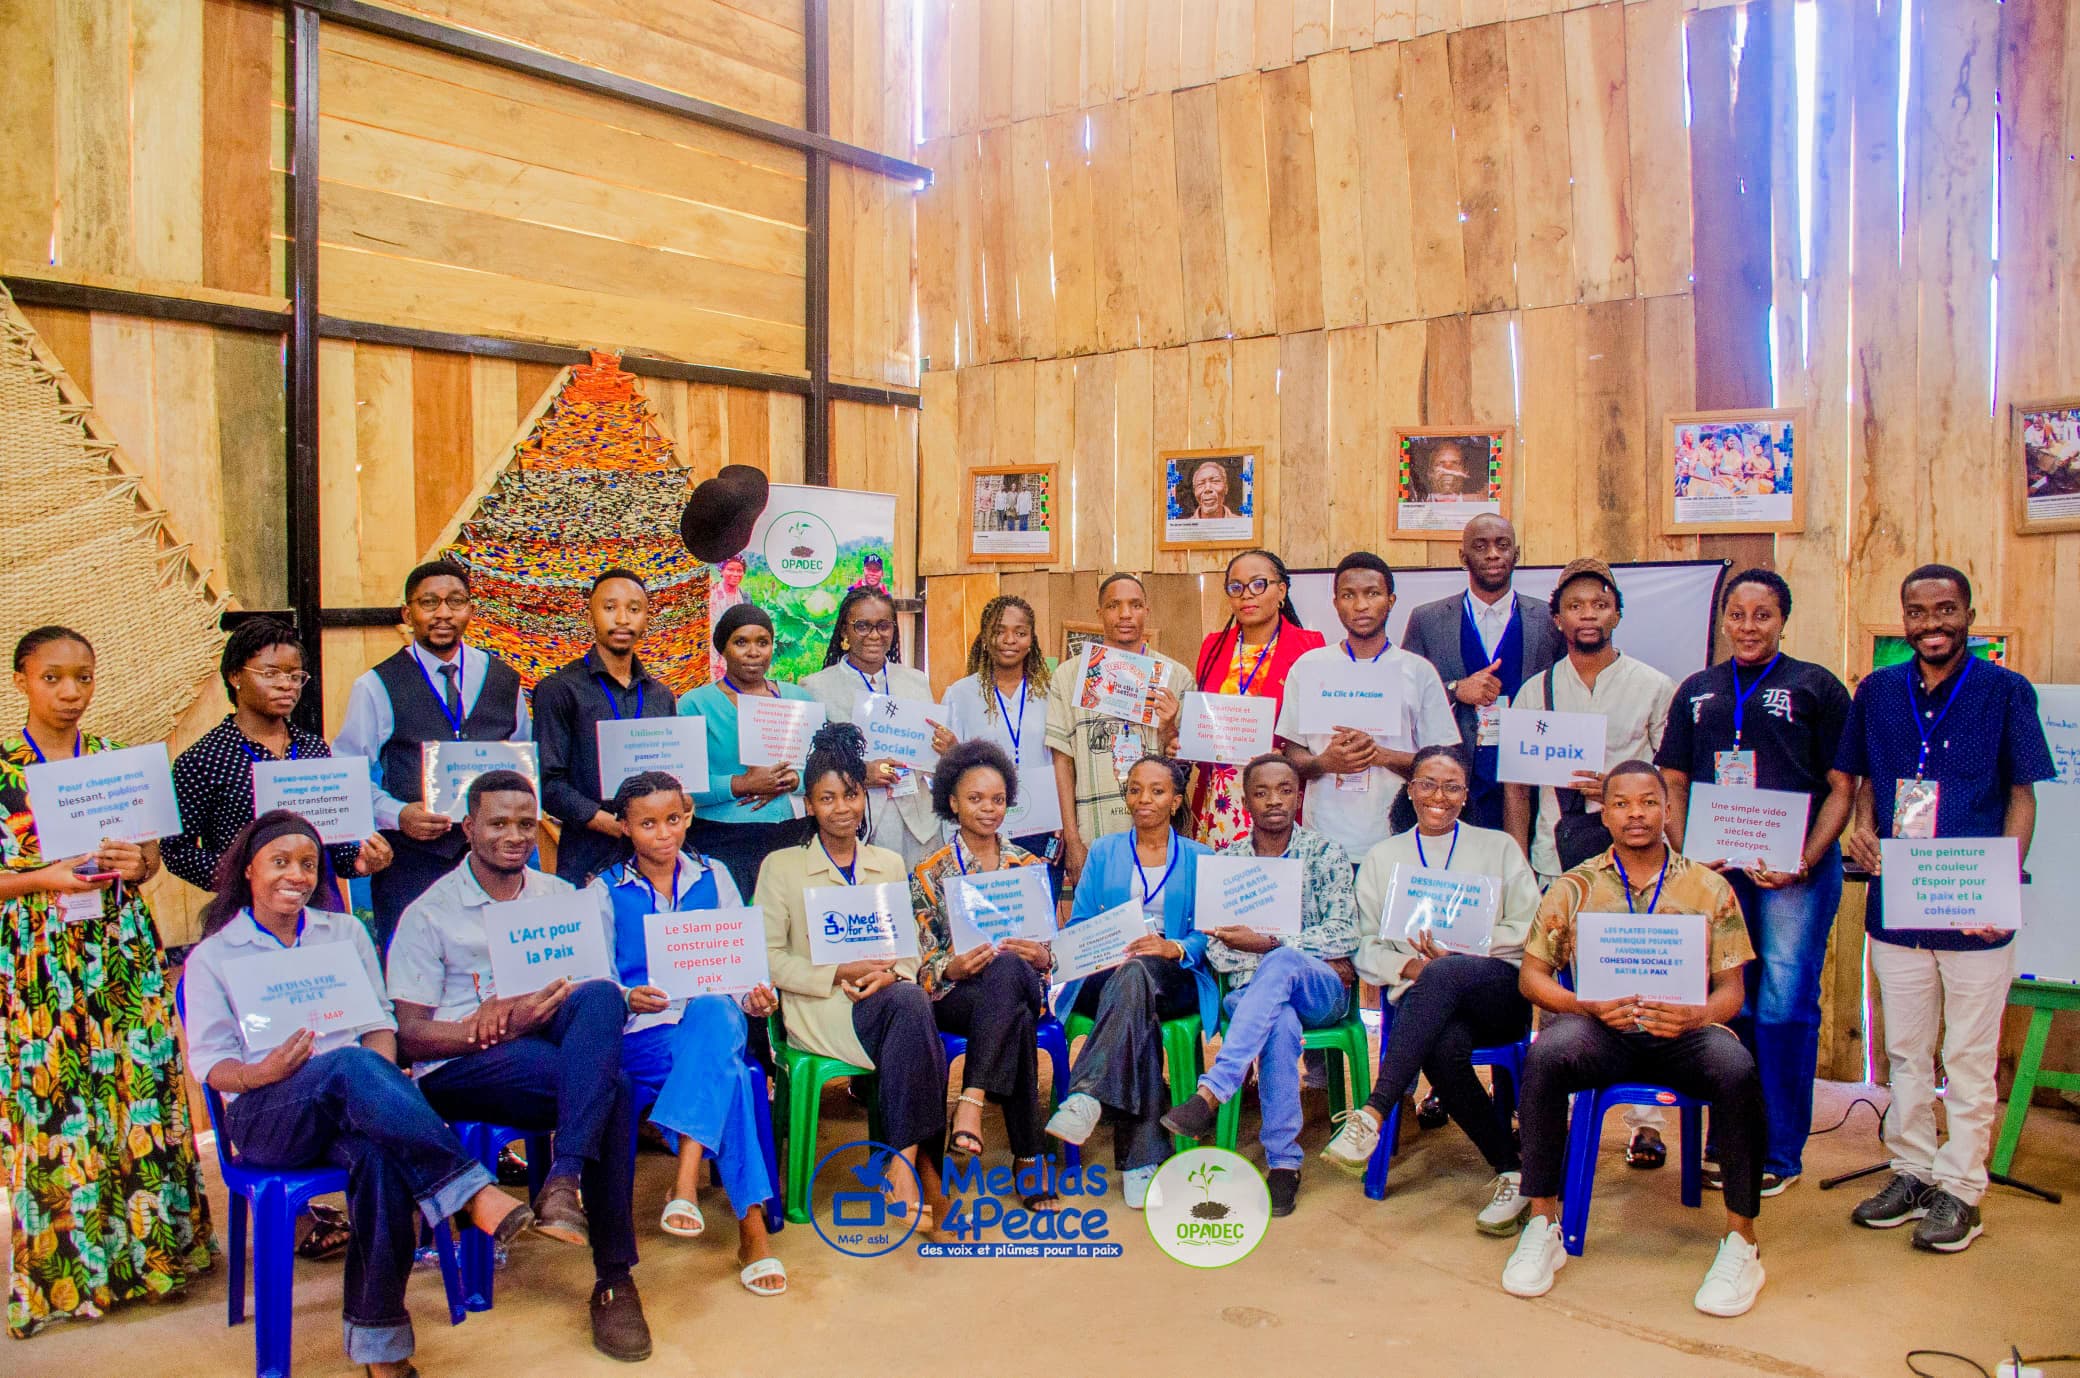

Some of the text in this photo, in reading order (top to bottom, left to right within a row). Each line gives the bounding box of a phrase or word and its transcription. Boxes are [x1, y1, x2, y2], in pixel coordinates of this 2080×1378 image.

[782, 559, 824, 571] OPADEC
[1355, 690, 1384, 698] l'Action
[870, 721, 926, 740] Cohesion
[475, 748, 487, 757] La
[873, 739, 917, 757] Sociale
[1519, 740, 1584, 760] La paix
[634, 753, 659, 762] panser
[447, 762, 516, 773] photographie
[58, 770, 145, 793] Pour chaque mot
[59, 782, 150, 807] blessant, publions
[277, 795, 349, 808] peut transformer
[71, 798, 144, 820] un message de
[296, 807, 338, 817] entalités
[1711, 801, 1787, 817] Une simple vidéo
[100, 816, 123, 829] paix.
[312, 818, 338, 828] stant?
[1714, 814, 1781, 829] peut briser des
[1724, 827, 1767, 839] siècles de
[1716, 838, 1772, 851] stéréotypes.
[1910, 847, 1985, 859] Une peinture
[1918, 862, 1979, 871] en couleur
[1223, 865, 1262, 886] CLIQUONS
[990, 878, 1020, 889] chaque
[1911, 877, 1986, 888] d'Espoir pour
[1222, 882, 1278, 910] UNE PAIX SANS
[1224, 884, 1245, 897] POUR
[1465, 885, 1481, 894] UN
[1917, 891, 1983, 903] la paix et la
[1924, 905, 1976, 915] cohésion
[509, 921, 581, 944] L'Art pour
[665, 921, 743, 935] Le Slam pour
[1619, 927, 1646, 935] PLATES
[667, 937, 745, 952] construire et
[1648, 937, 1683, 945] PEUVENT
[526, 944, 575, 965] la Paix
[1615, 947, 1656, 955] FAVORISER
[674, 953, 742, 971] repenser la
[1600, 956, 1640, 965] COHESION
[1641, 957, 1673, 966] SOCIALE
[1638, 968, 1649, 976] LA
[1650, 968, 1668, 976] PAIX
[267, 974, 336, 993] MEDIAS FOR
[697, 973, 722, 987] paix
